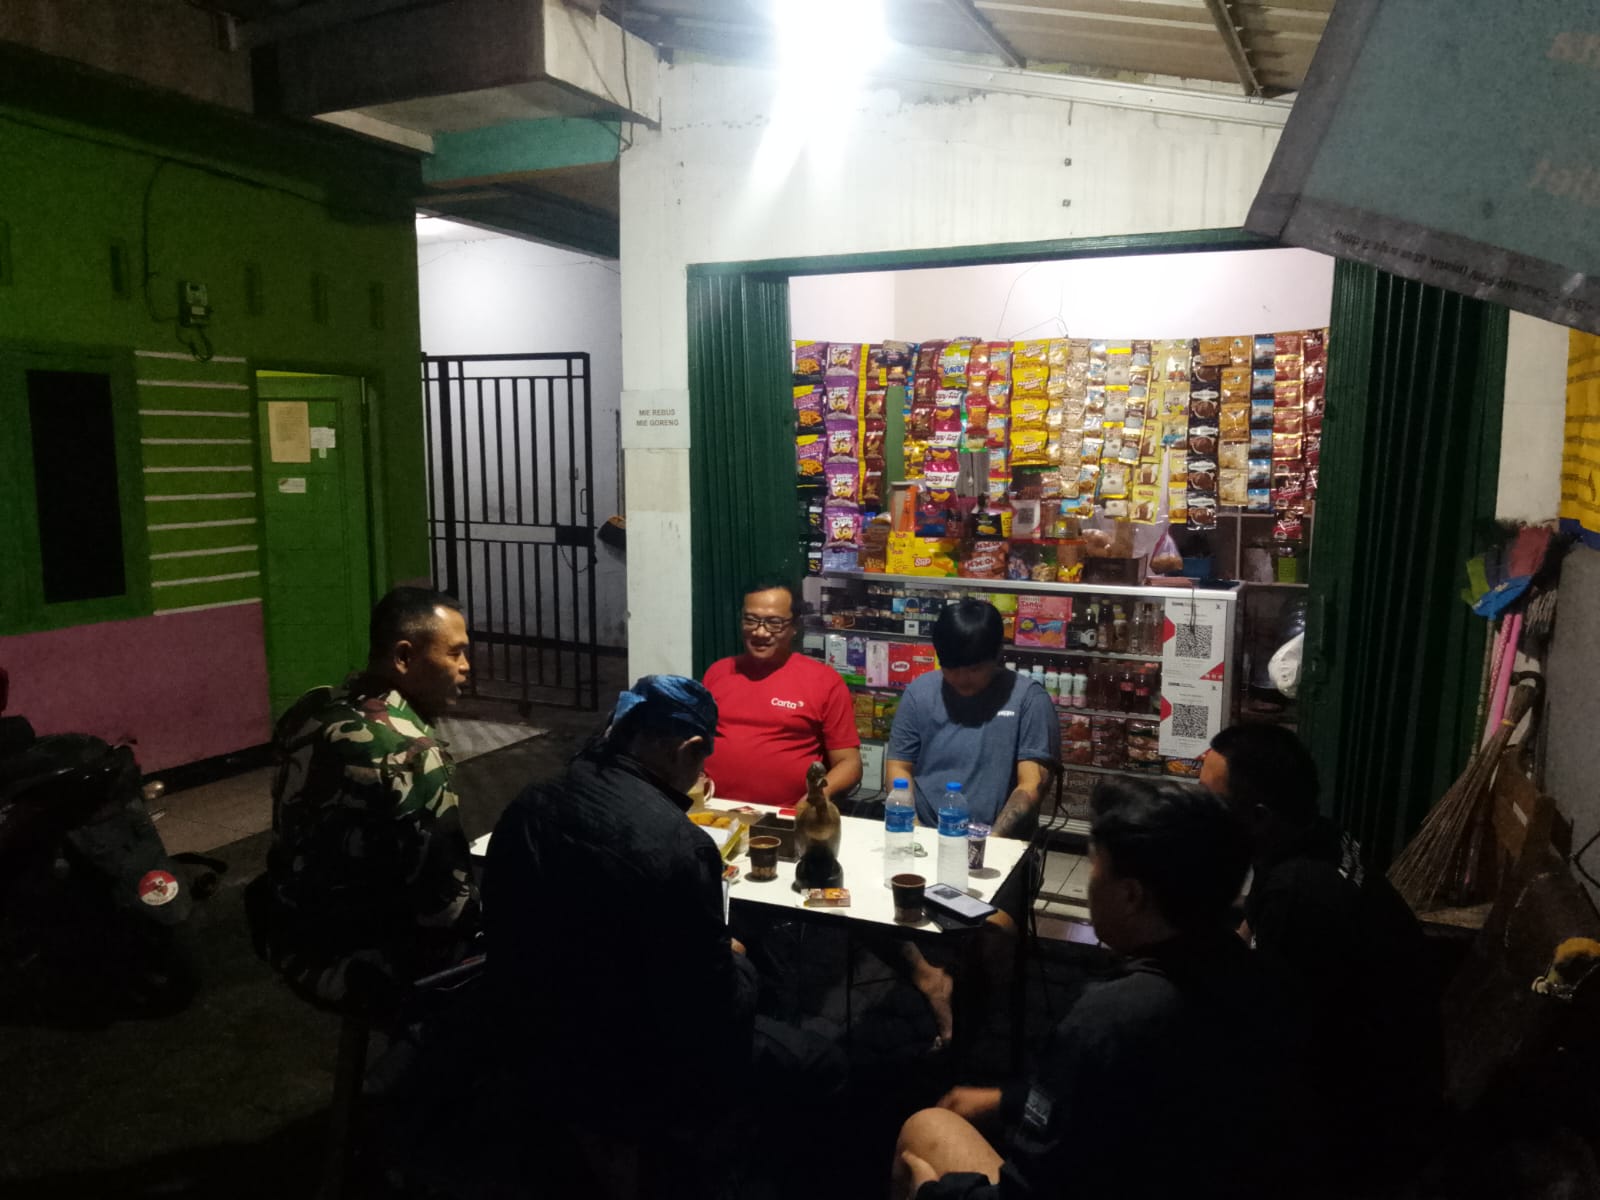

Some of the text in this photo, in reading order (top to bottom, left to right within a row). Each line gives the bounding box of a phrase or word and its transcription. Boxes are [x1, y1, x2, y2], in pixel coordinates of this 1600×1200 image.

[652, 408, 676, 416] REBUS
[636, 419, 679, 427] MIE GORENG
